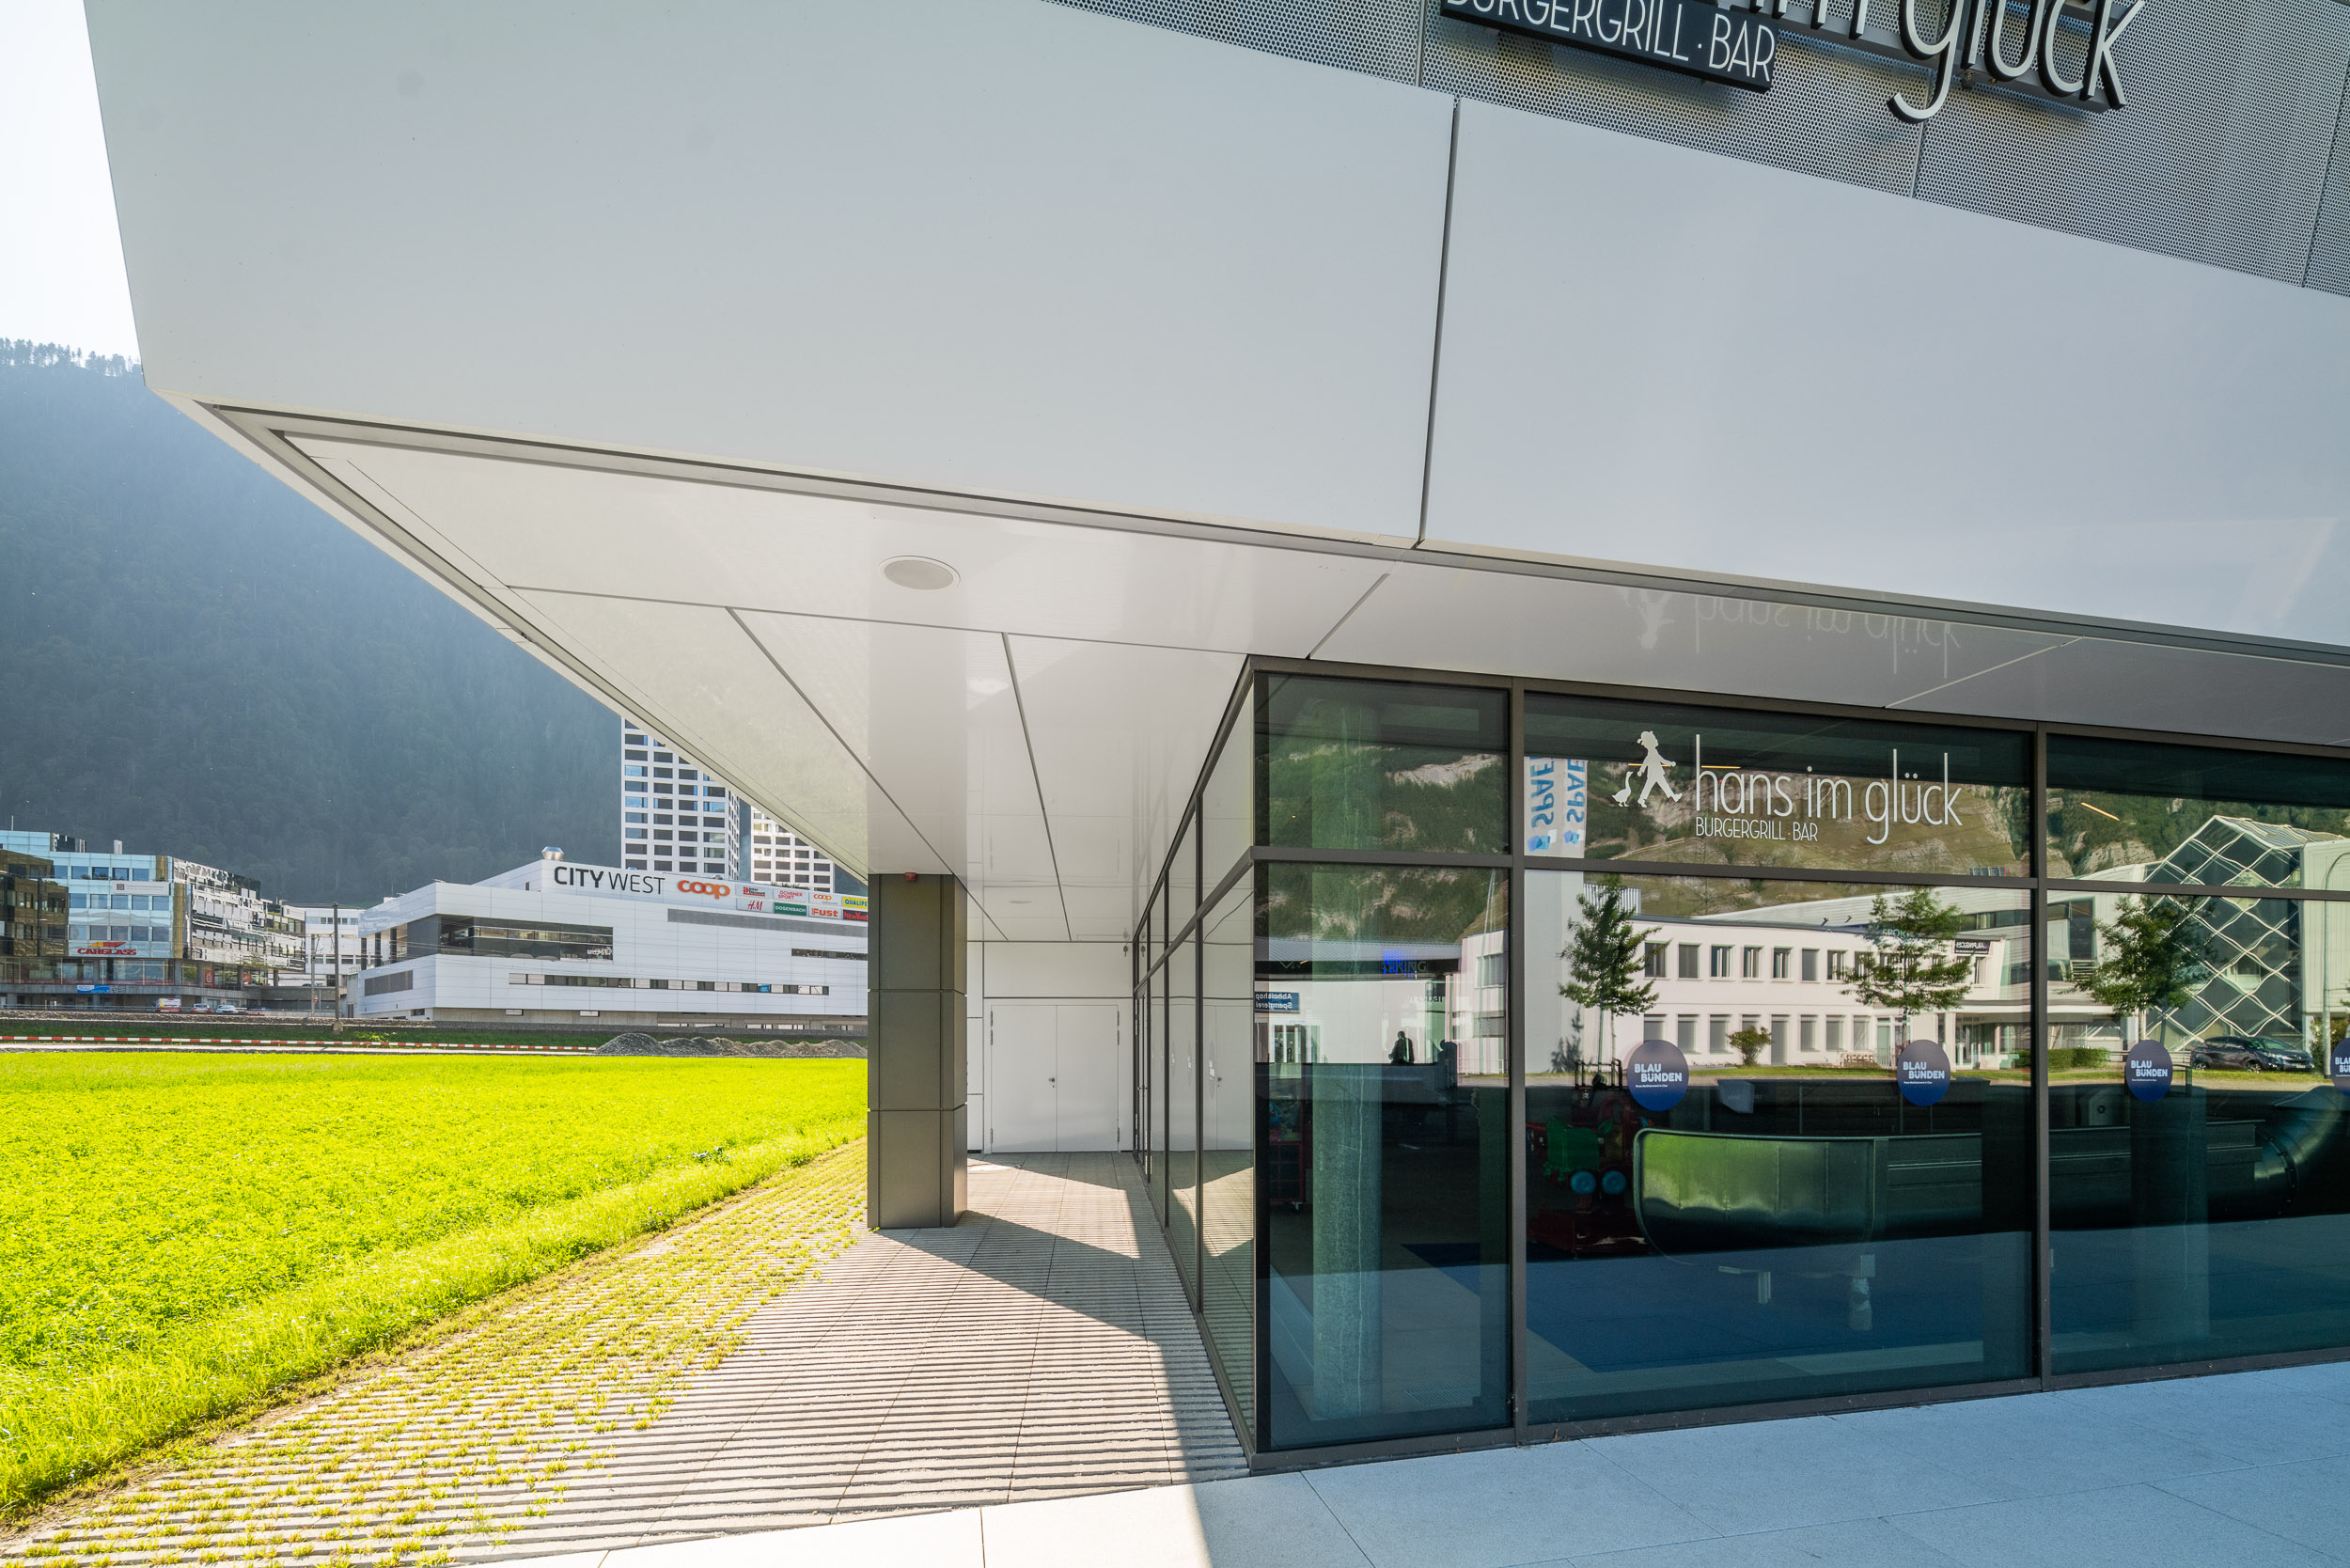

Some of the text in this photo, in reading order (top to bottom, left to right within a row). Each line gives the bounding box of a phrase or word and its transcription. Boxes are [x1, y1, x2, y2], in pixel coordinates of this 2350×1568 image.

[1708, 13, 1776, 83] BAR
[1695, 733, 1963, 845] hans im glück
[1696, 816, 1818, 842] BURGERGRILL BAR
[554, 866, 666, 895] CITY WEST
[678, 879, 731, 900] coop
[813, 893, 833, 902] coop
[747, 901, 762, 910] H&M
[77, 948, 137, 956] CARGLASS
[1634, 1063, 1662, 1074] BLAU
[1903, 1061, 1927, 1071] BLAU
[2130, 1059, 2153, 1069] BLAU
[1640, 1072, 1683, 1083] BÜNDEN
[1908, 1070, 1945, 1079] BÜNDEN
[2136, 1068, 2169, 1077] BÜNDEN
